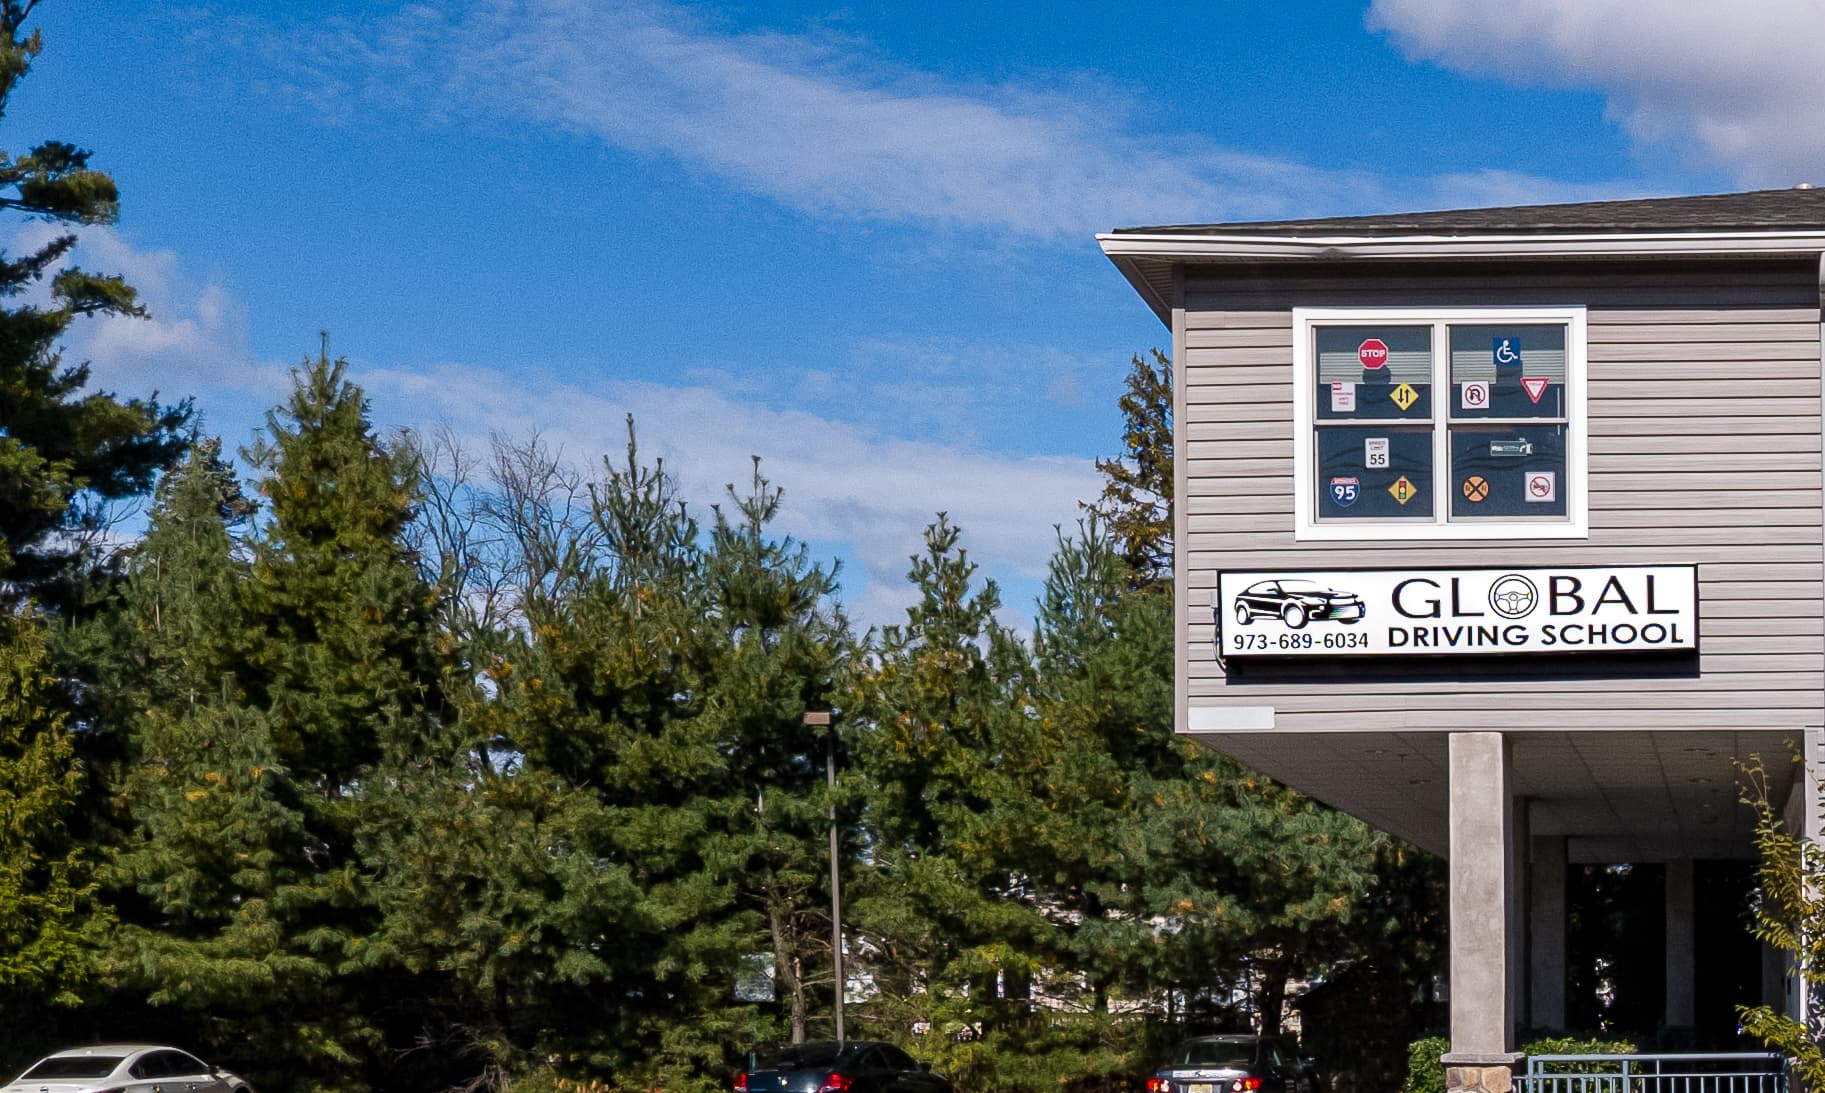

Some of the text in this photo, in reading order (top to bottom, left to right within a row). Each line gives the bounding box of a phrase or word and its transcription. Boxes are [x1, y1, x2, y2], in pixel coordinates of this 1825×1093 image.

[1361, 349, 1386, 358] STOP
[1370, 453, 1386, 465] 55
[1334, 485, 1356, 500] 95
[1391, 573, 1680, 620] GLOBAL
[1233, 632, 1369, 650] 973-689-6034
[1388, 622, 1684, 647] DRIVING SCHOOL
